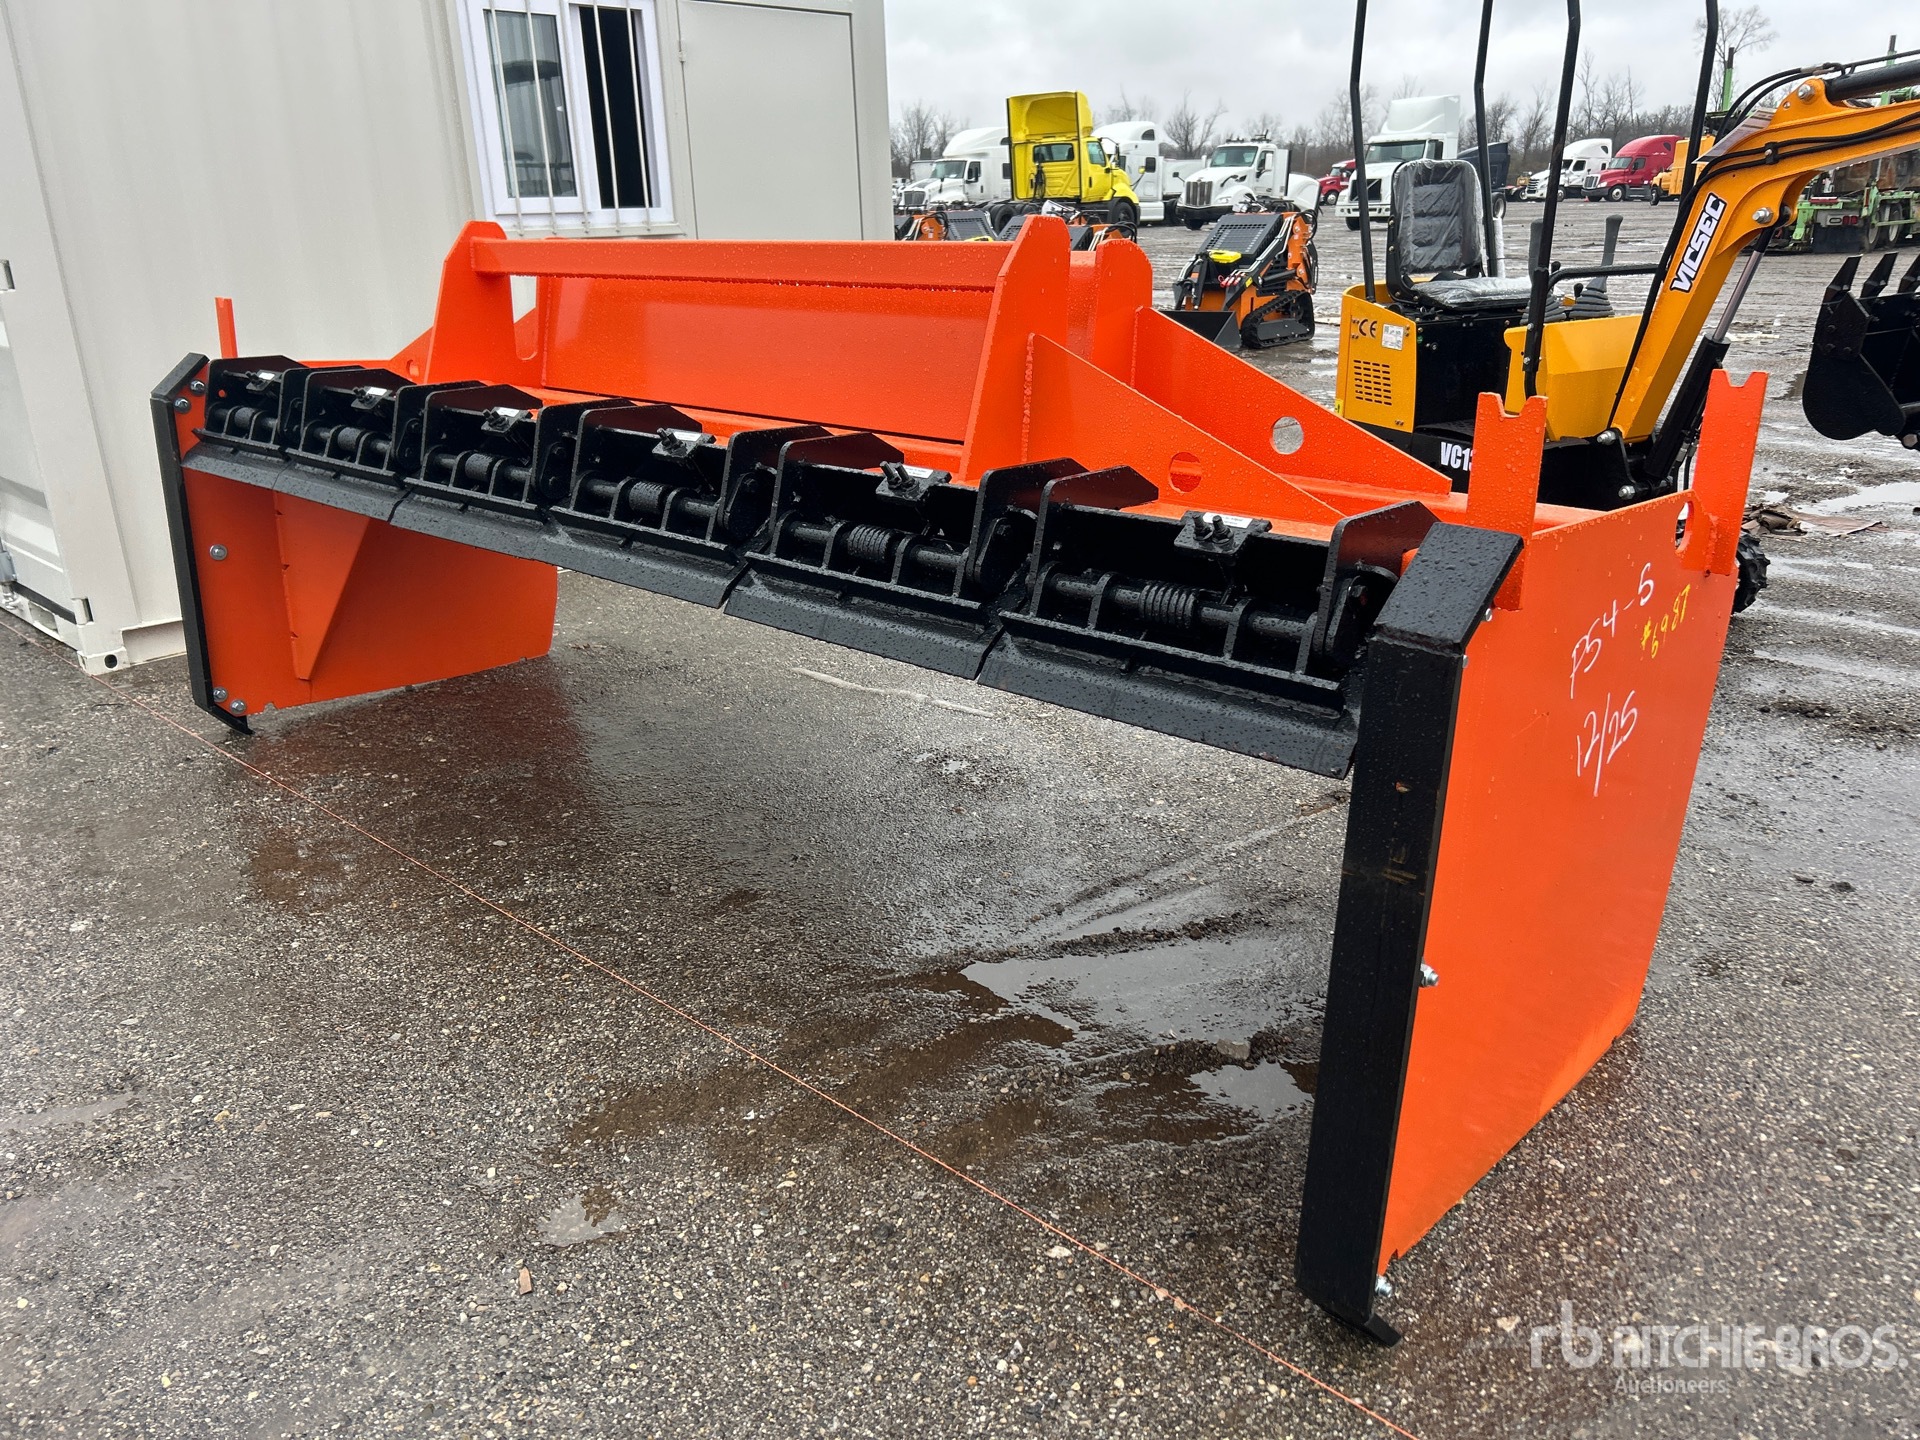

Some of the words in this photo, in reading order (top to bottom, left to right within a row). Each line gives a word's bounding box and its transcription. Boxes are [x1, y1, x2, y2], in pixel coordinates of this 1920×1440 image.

[1670, 192, 1727, 292] VICSEC
[1359, 319, 1377, 338] CE
[1440, 441, 1473, 472] VC1
